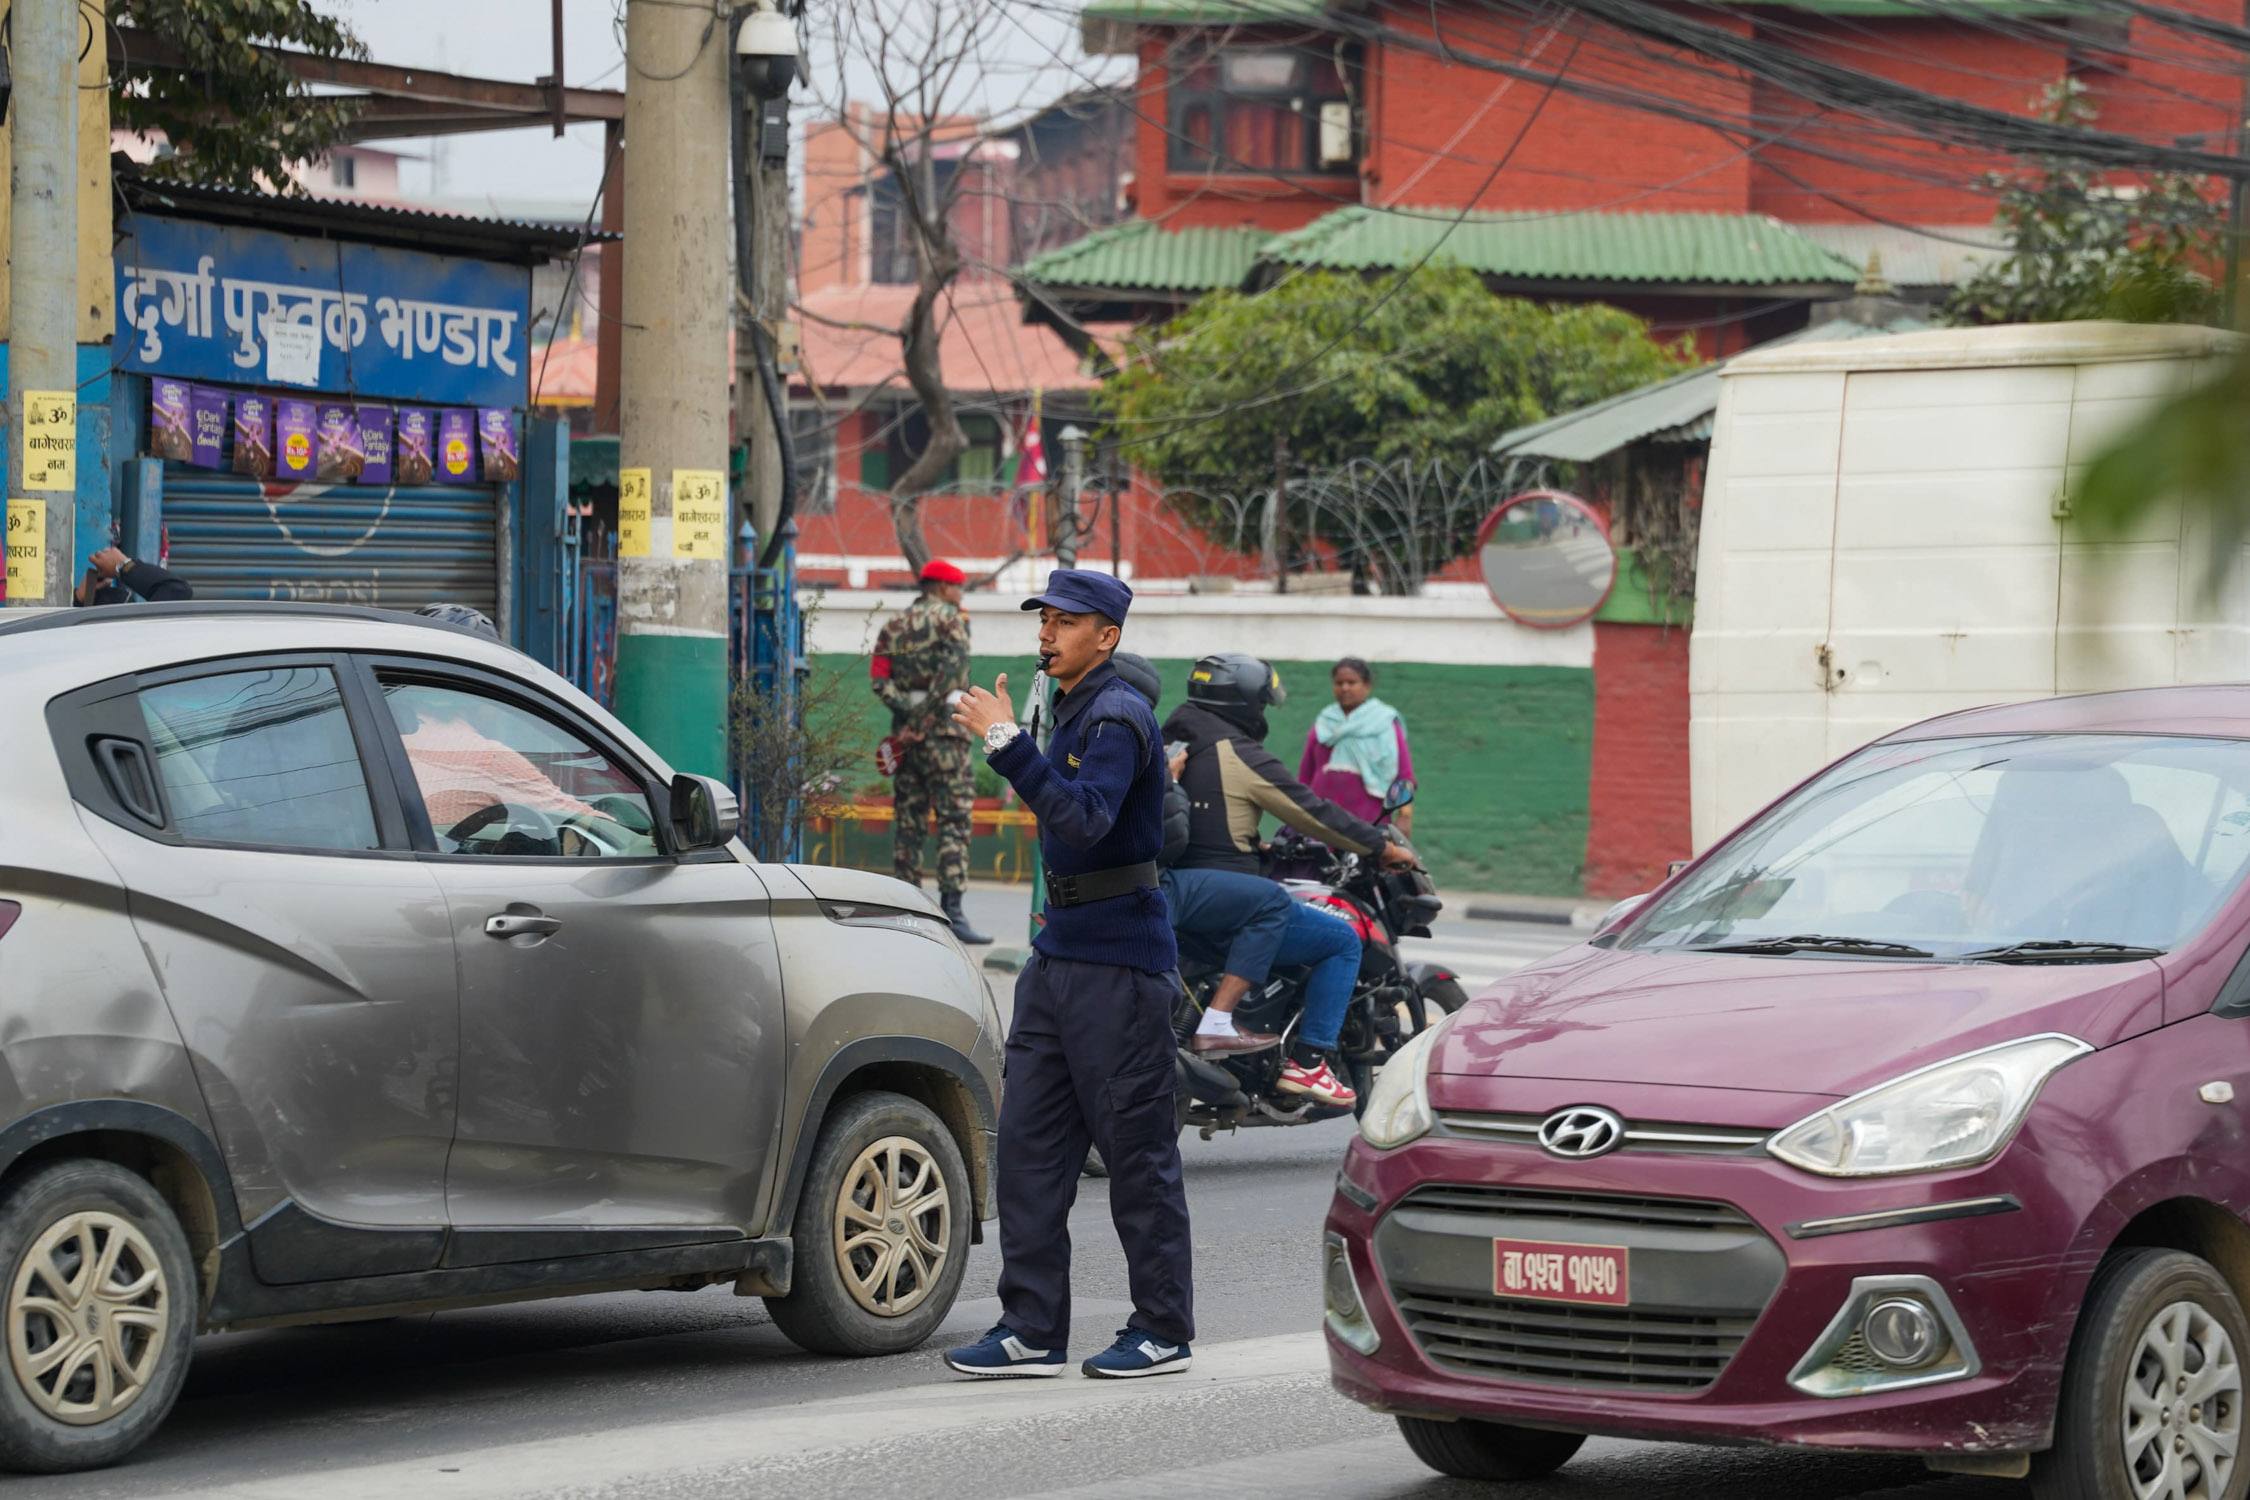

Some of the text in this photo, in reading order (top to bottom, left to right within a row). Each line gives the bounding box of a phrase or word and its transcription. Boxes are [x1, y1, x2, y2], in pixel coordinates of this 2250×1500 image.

[123, 255, 215, 363] दुर्गा
[375, 297, 518, 377] भण्डार
[1568, 1255, 1617, 1295] १०५०
